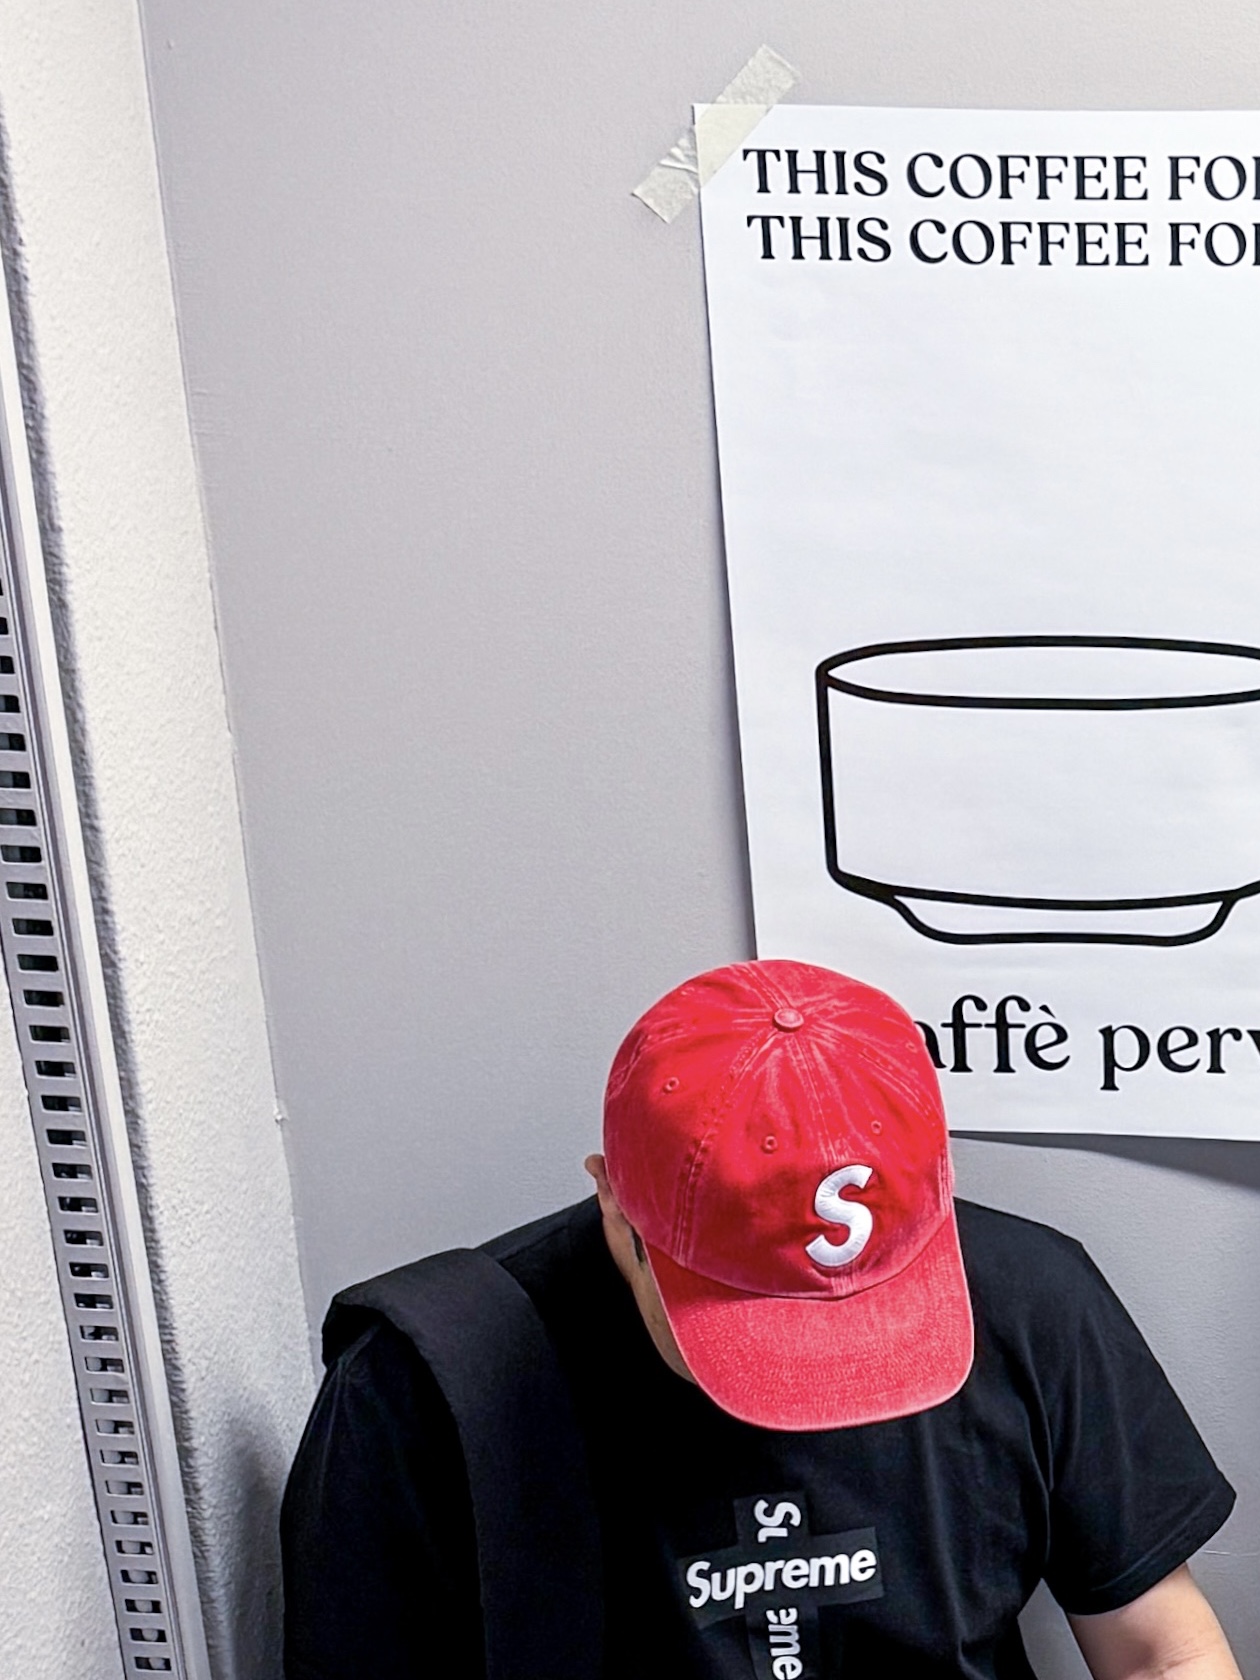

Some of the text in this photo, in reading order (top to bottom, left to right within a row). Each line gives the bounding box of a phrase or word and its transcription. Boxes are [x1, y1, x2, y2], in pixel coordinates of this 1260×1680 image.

[742, 148, 888, 197] THIS
[906, 152, 1149, 201] COFFEE
[746, 215, 892, 263] THIS
[909, 218, 1149, 267] COFFEE
[805, 1164, 873, 1267] S
[686, 1549, 877, 1610] Supreme
